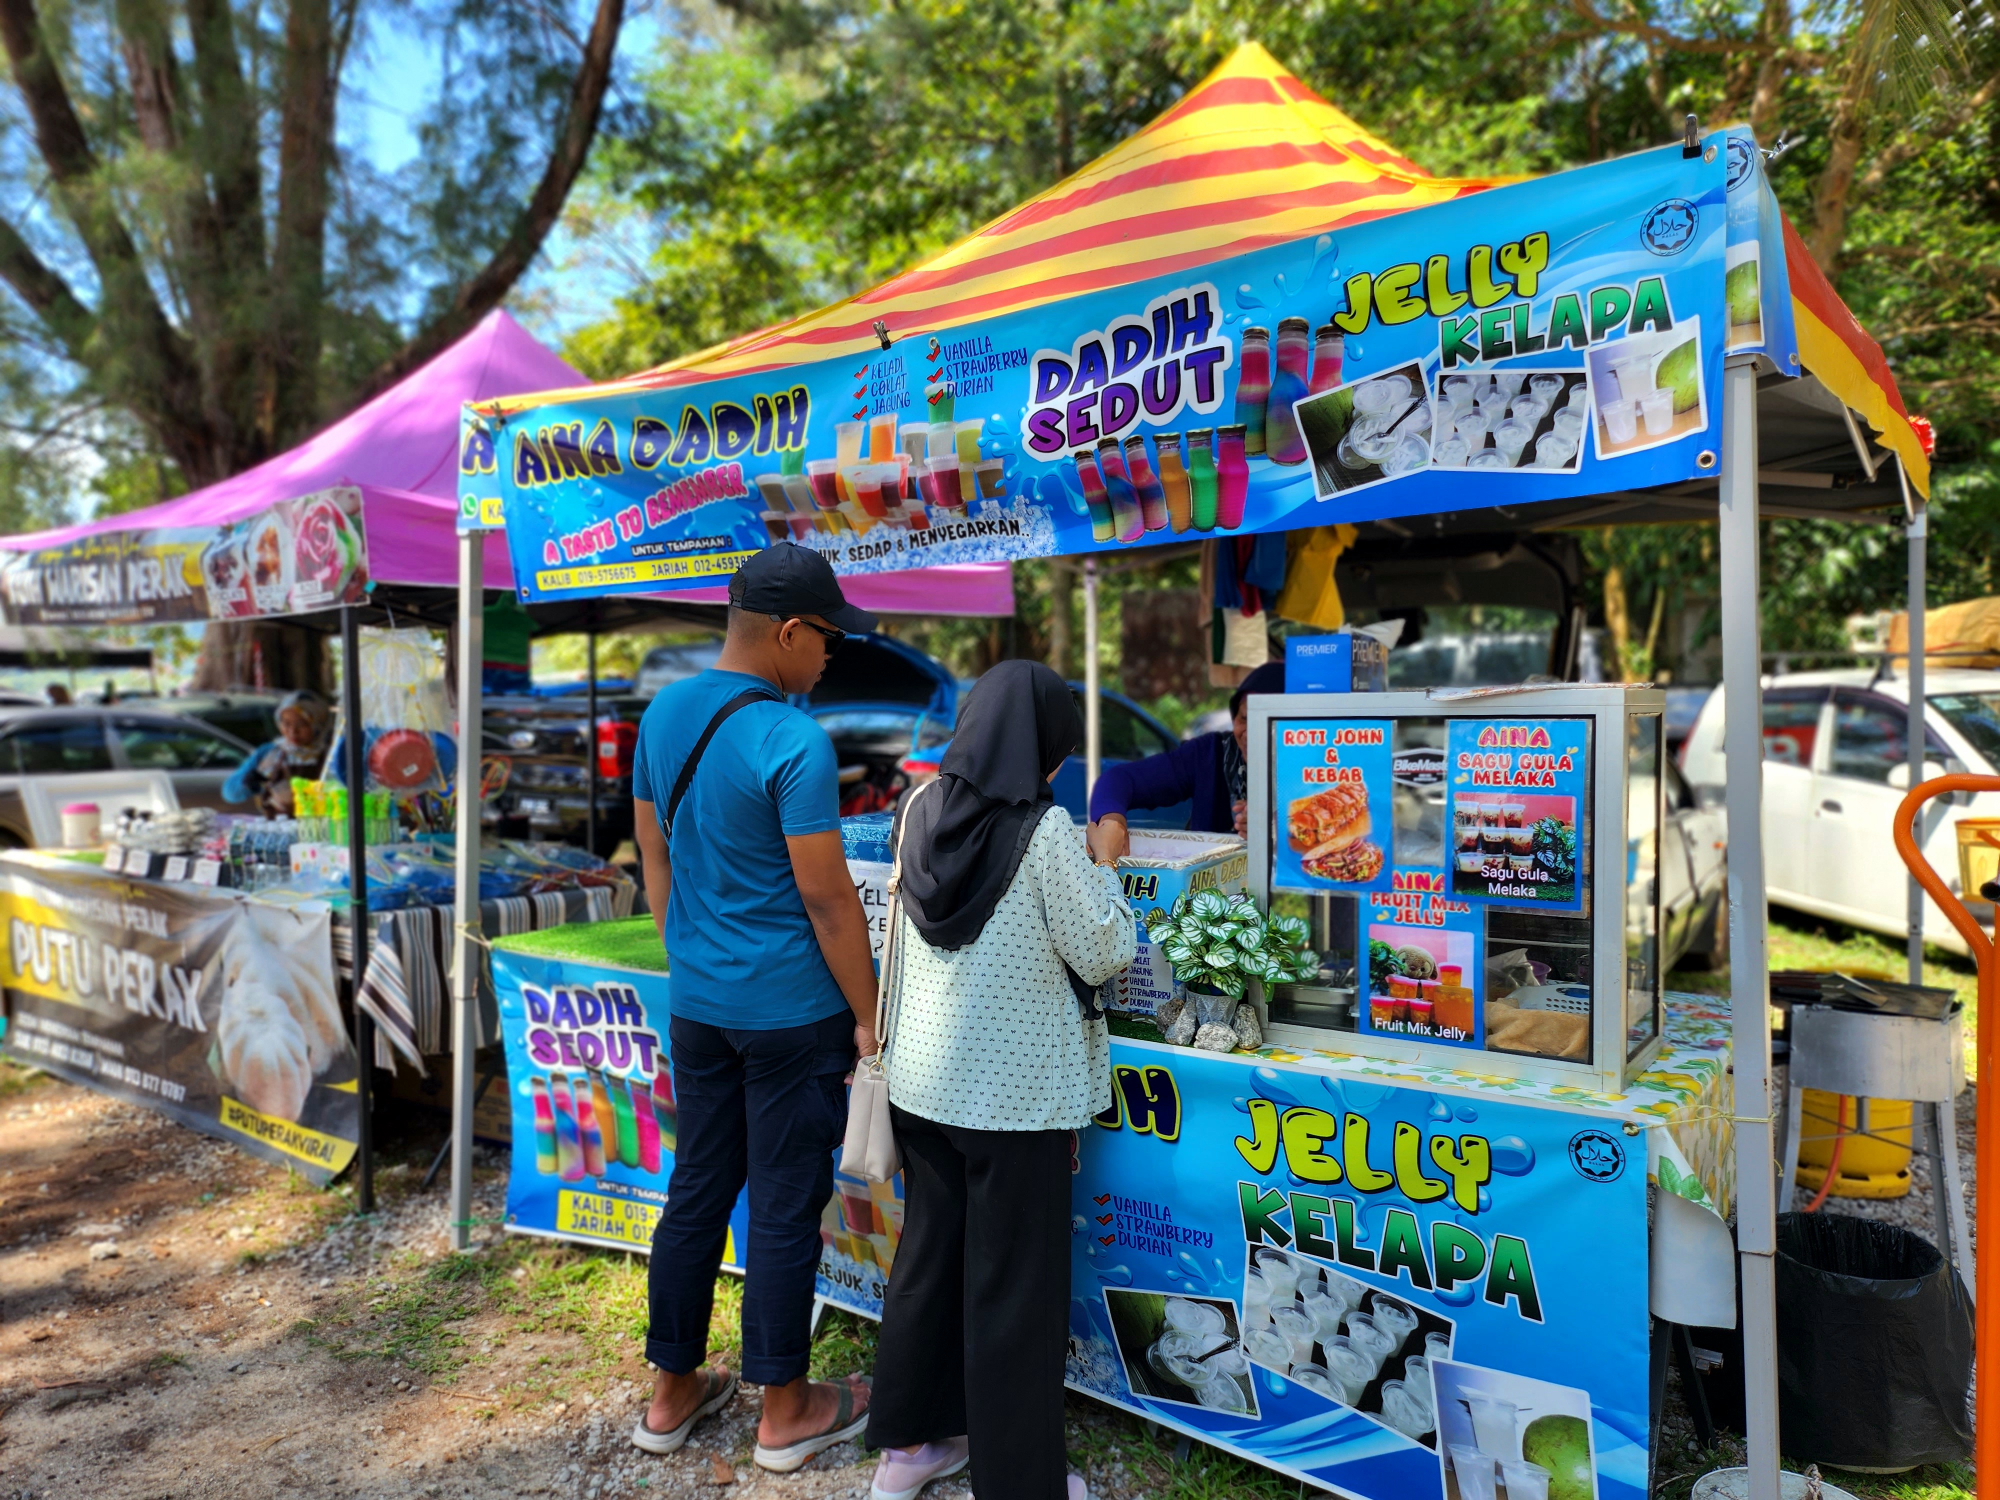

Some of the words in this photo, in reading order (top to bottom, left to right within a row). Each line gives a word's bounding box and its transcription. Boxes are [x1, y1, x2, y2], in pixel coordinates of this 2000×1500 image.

[1332, 230, 1550, 336] JELLY
[1440, 277, 1673, 368] KELAPA
[943, 336, 993, 361] VANILLA
[1034, 290, 1214, 404] DADIH
[871, 356, 903, 380] KELADI
[946, 347, 1028, 381] STRAWBERRY
[871, 373, 907, 397] COKLAT
[946, 376, 994, 399] DURIAN
[871, 392, 911, 415] JAGUNG
[1028, 345, 1225, 453] SEDUT
[515, 418, 623, 488] AINA
[630, 384, 812, 470] DADIH
[544, 539, 561, 565] A
[560, 519, 617, 562] TASTE
[615, 505, 643, 540] TO
[646, 462, 749, 527] REMEMBER
[631, 545, 665, 557] UNTUK
[666, 537, 726, 553] TEMPAHAN
[848, 540, 892, 563] SEDAP
[896, 540, 905, 553] &
[542, 573, 571, 587] KALIB
[577, 567, 637, 583] 019-5756675
[651, 562, 689, 577] JARIAH
[1296, 644, 1337, 655] PREMIER
[1284, 730, 1327, 745] ROTI
[1333, 729, 1384, 745] JOHN
[1478, 726, 1551, 749] AINA
[1325, 748, 1340, 764] &
[1458, 752, 1512, 770] SAGU
[1519, 754, 1574, 771] GULA
[1303, 766, 1364, 784] KEBAB
[1472, 769, 1557, 788] MELAKA
[1189, 868, 1217, 897] AINA
[1480, 865, 1514, 882] Sagu
[1517, 867, 1549, 882] Gula
[1371, 891, 1424, 908] FRUIT
[1488, 882, 1537, 897] Melaka
[1394, 909, 1446, 926] JELLY
[10, 917, 93, 996] PUTU
[1128, 967, 1154, 977] JAGUNG
[1129, 977, 1155, 987] VANILLA
[1129, 987, 1171, 1000] STRAWBERRY
[1129, 998, 1154, 1009] DURIAN
[523, 985, 644, 1030] DADIH
[1374, 1017, 1404, 1033] Fruit
[1407, 1020, 1432, 1035] Mix
[1434, 1025, 1467, 1042] Jelly
[530, 1028, 658, 1074] SEDUT
[1234, 1098, 1491, 1215] JELLY
[597, 1181, 629, 1195] UNTUK
[572, 1194, 615, 1216] KALIB
[1113, 1195, 1173, 1223] VANILLA
[571, 1213, 625, 1236] JARIAH
[1116, 1213, 1213, 1249] STRAWBERRY
[1118, 1230, 1173, 1257] DURIAN
[1240, 1181, 1544, 1324] KELAPA
